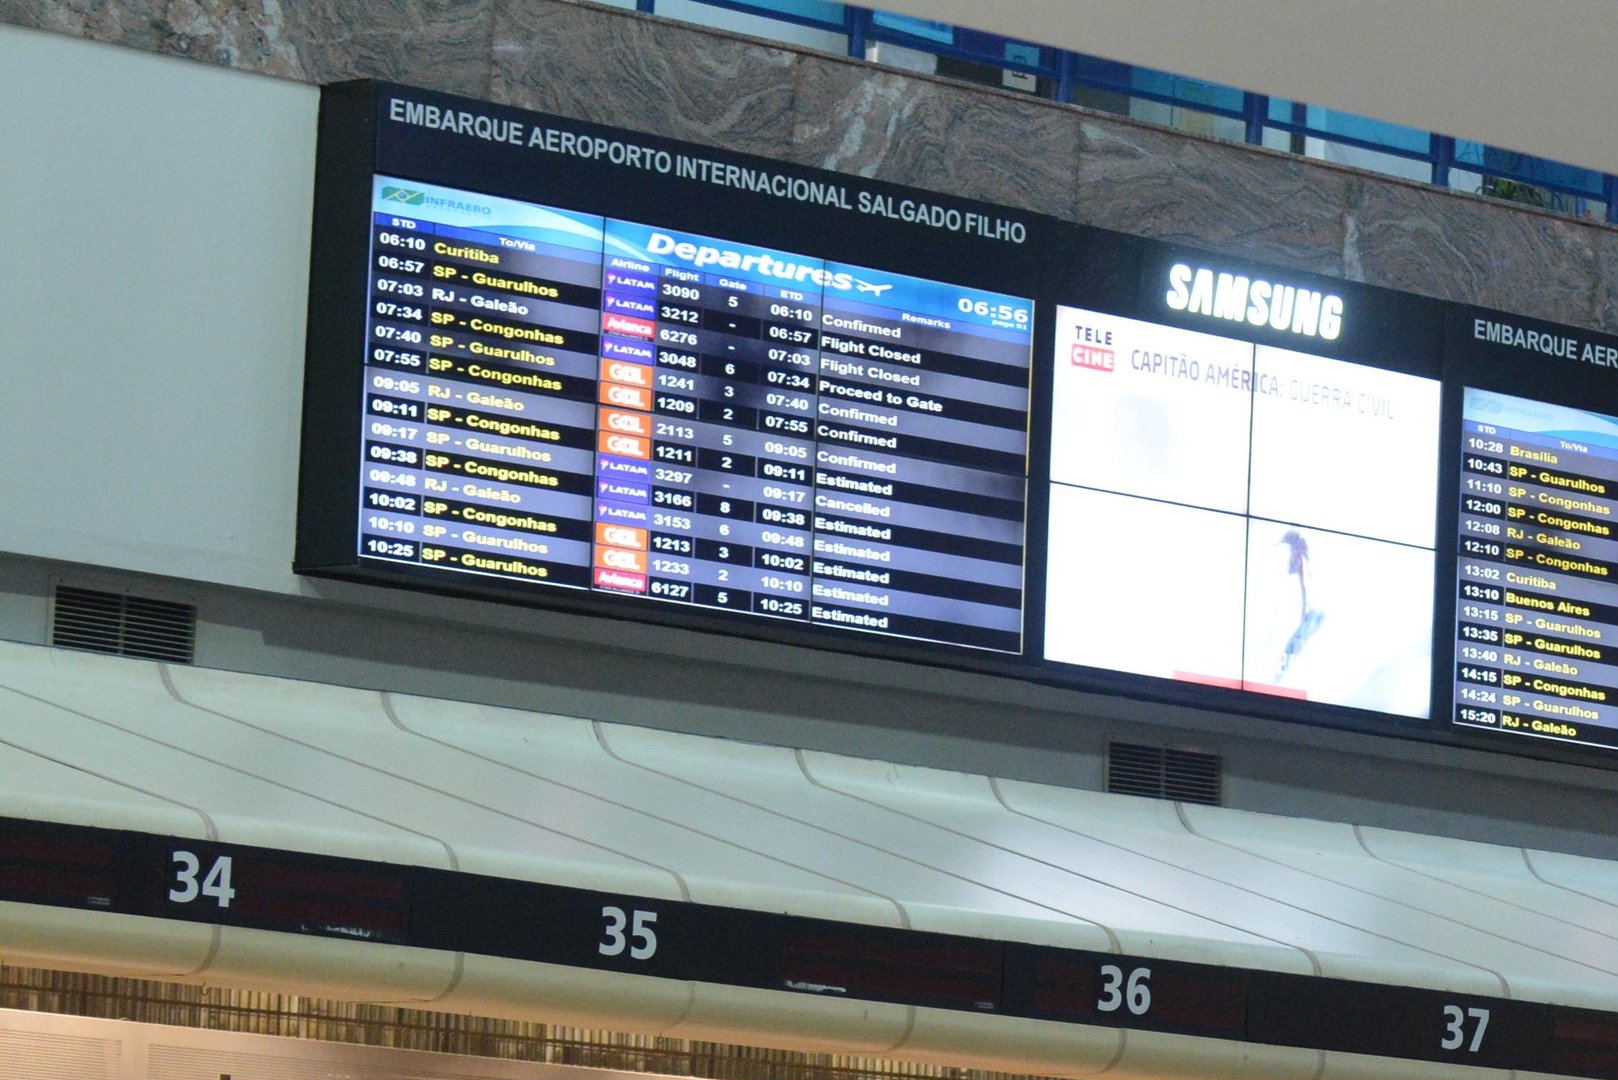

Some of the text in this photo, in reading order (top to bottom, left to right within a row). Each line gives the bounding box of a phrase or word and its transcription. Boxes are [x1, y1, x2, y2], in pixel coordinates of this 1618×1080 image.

[389, 97, 1026, 243] EMBARQUE AEROPORTO INTERNACIONAL SALGADO FILHO
[424, 195, 491, 215] INFRAERO
[391, 217, 416, 229] STD
[379, 231, 426, 250] 06:10
[499, 237, 535, 251] To/Via
[433, 242, 499, 264] Curitiba
[646, 232, 853, 290] Departures
[378, 255, 424, 273] 06:57
[611, 258, 650, 272] Airline
[664, 267, 699, 281] Flight
[377, 278, 424, 297] 07:03
[432, 265, 558, 298] SP Guarulhos
[616, 276, 654, 290] LATAM
[662, 283, 700, 300] 3090
[719, 278, 747, 290] Gate
[431, 287, 529, 315] RJ Galeão
[780, 289, 803, 301] ETD
[1166, 264, 1344, 340] SAMSUNG
[376, 301, 423, 320] 07:34
[958, 297, 1028, 323] 06:56
[430, 311, 564, 345] SP Congonhas
[901, 312, 951, 329] Remarks
[375, 325, 421, 343] 07:40
[659, 328, 697, 345] 6276
[1075, 325, 1113, 346] TELE
[1474, 318, 1577, 360] EMBARQUE
[373, 348, 421, 367] 07:55
[429, 334, 555, 366] SP Guarulhos
[820, 335, 921, 364] Flight Closed
[1072, 345, 1114, 370] CINE
[428, 357, 562, 390] SP Congonhas
[658, 374, 694, 390] 1241
[1131, 349, 1200, 381] CAPITÃO
[1205, 362, 1283, 398] AMÉRICA:
[373, 375, 420, 394] 09:05
[427, 384, 524, 411] RJ Galeão
[818, 379, 943, 412] Proceed to Gate
[371, 398, 417, 417] 09:11
[371, 422, 418, 440] 09:17
[426, 407, 560, 440] SP Congonhas
[656, 422, 694, 439] 2113
[817, 424, 897, 448] Confirmed
[1468, 437, 1503, 453] 10:28
[370, 445, 417, 464] 09:38
[425, 431, 551, 462] SP Guarulhos
[1509, 445, 1558, 464] Brasília
[424, 454, 559, 486] SP Congonhas
[655, 467, 692, 484] 3297
[1467, 457, 1503, 474] 10:43
[369, 469, 416, 487] 09:48
[815, 472, 893, 496] Estimated
[1466, 478, 1502, 494] 11:10
[1508, 465, 1605, 494] SP Guarulhos
[424, 477, 521, 503] RJ Galeão
[369, 492, 416, 511] 10:02
[815, 495, 890, 517] Cancelled
[1466, 499, 1501, 515] 12:00
[1508, 486, 1610, 515] SP Congonhas
[368, 516, 415, 534] 10:10
[423, 500, 557, 532] SP Congonhas
[653, 513, 691, 530] 3153
[1507, 506, 1610, 535] SP Congonhas
[814, 516, 891, 540] Estimated
[1465, 519, 1500, 535] 12:08
[367, 539, 414, 557] 10:25
[422, 524, 548, 554] SP Guarulhos
[1464, 540, 1499, 556] 12:10
[1506, 526, 1581, 550] RJ Galeão
[421, 547, 548, 577] SP Guarulhos
[652, 559, 690, 575] 1233
[1505, 547, 1608, 575] SP Congonhas
[812, 561, 890, 584] Estimated
[1464, 564, 1500, 580] 13:02
[1505, 571, 1556, 590] Curitiba
[1463, 584, 1499, 600] 13:10
[1463, 605, 1499, 621] 13:15
[1505, 591, 1590, 616] Buenos Aires
[1462, 625, 1498, 641] 13:35
[1504, 612, 1601, 639] SP Guarulhos
[1461, 646, 1498, 662] 13:40
[1503, 632, 1601, 659] SP Guarulhos
[1503, 653, 1578, 675] RJ Galeão
[1461, 667, 1497, 683] 14:15
[1460, 687, 1496, 703] 14:24
[1502, 673, 1606, 700] SP Congonhas
[1460, 708, 1496, 724] 15:20
[1502, 694, 1599, 720] SP Guarulhos
[1501, 714, 1577, 736] RJ Galeão
[169, 850, 236, 908] 34
[598, 906, 658, 960] 35
[1097, 964, 1151, 1015] 36
[1441, 1005, 1490, 1052] 37
